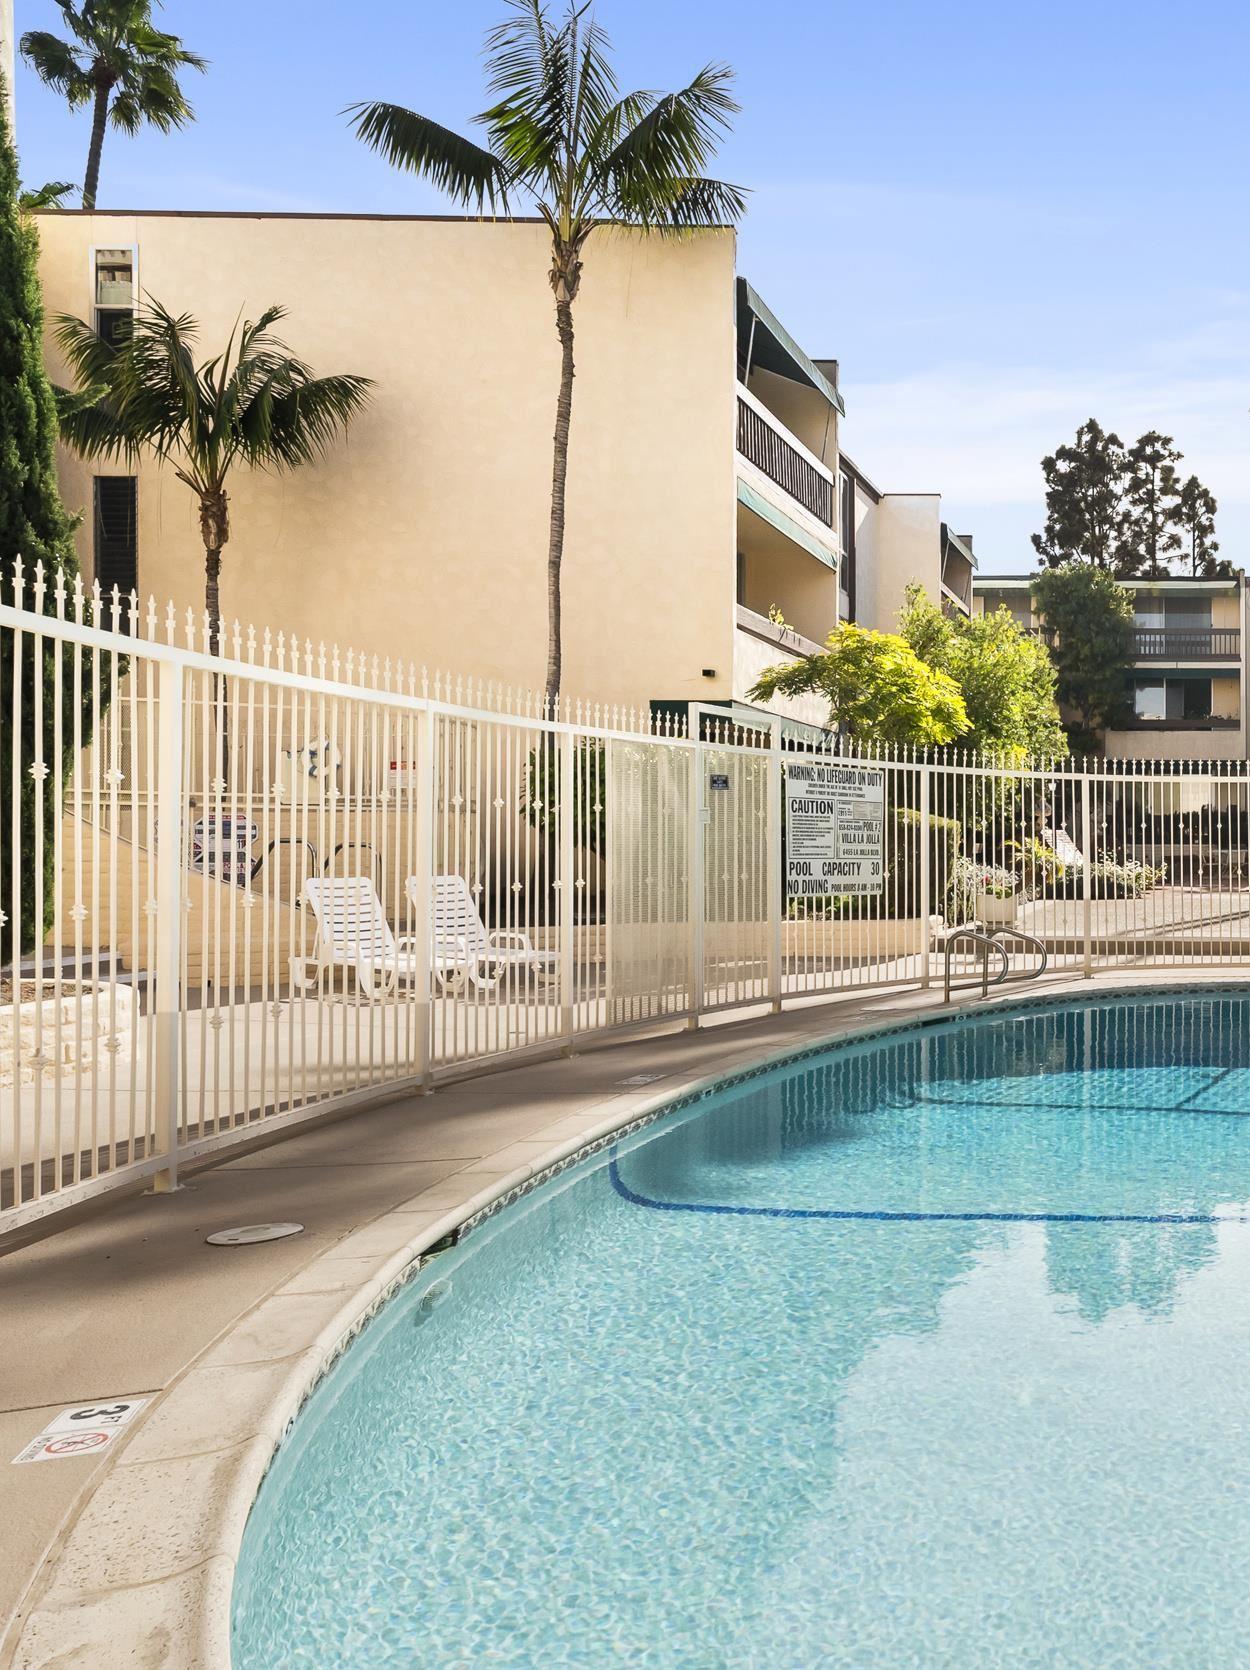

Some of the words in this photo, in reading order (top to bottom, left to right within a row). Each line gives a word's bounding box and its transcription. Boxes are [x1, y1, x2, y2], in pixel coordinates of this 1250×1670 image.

[817, 768, 825, 783] NO
[827, 769, 856, 785] LIFEGUARD
[857, 771, 866, 786] ON
[867, 772, 882, 787] DUTY
[791, 799, 833, 815] CAUTION
[842, 833, 856, 844] VILLA
[857, 833, 864, 844] LA
[865, 833, 880, 844] JOLLA
[789, 861, 813, 876] POOL
[822, 861, 861, 876] CAPACITY
[870, 861, 880, 876] 30
[787, 879, 799, 894] NO
[801, 879, 828, 894] DIVING
[831, 883, 842, 892] POOL
[843, 883, 857, 892] HOURS
[70, 1404, 130, 1420] 3
